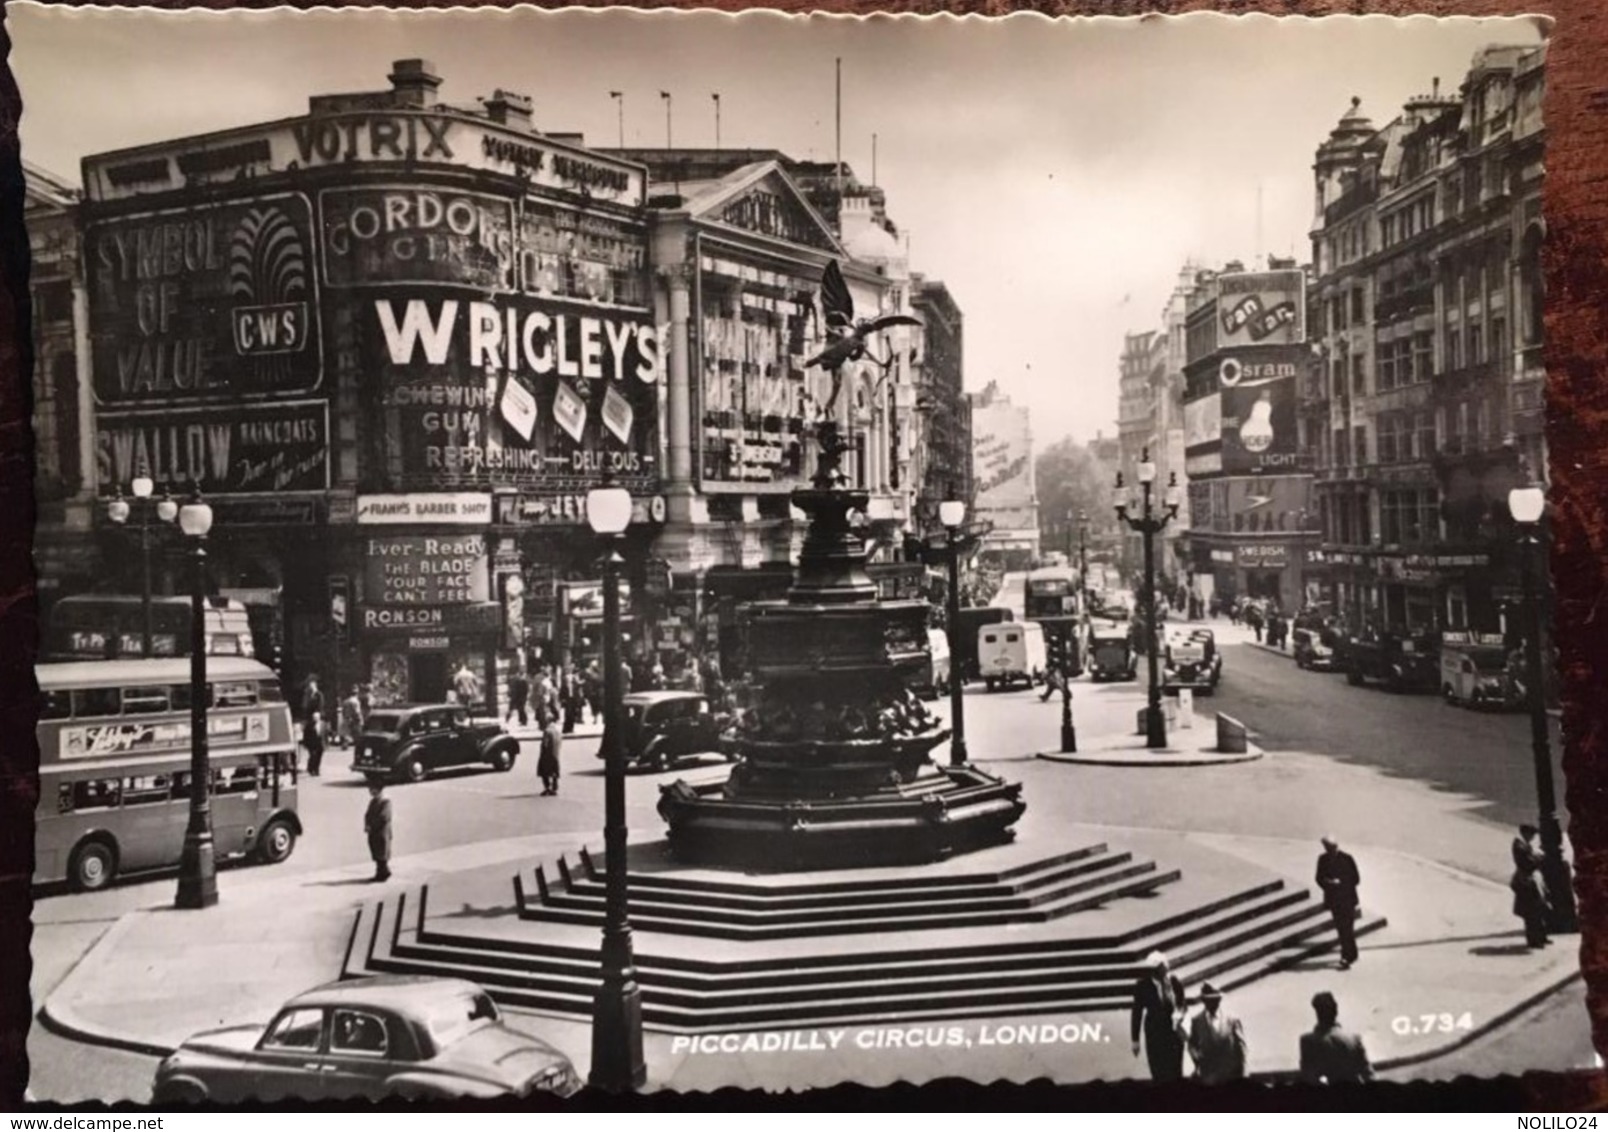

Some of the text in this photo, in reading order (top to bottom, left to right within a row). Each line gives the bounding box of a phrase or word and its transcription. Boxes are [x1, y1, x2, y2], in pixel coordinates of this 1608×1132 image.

[292, 114, 453, 162] VOTRIX
[98, 220, 223, 281] SYMBOL
[138, 283, 180, 335] OF
[240, 311, 296, 348] CWS
[374, 299, 659, 384] WRIGLEY'S
[1220, 358, 1296, 386] Osram
[394, 385, 496, 407] CHEWING
[422, 412, 480, 432] GUM
[98, 425, 231, 484] SWALLOW
[427, 446, 640, 471] REFRESHING DELIOUS
[1259, 454, 1296, 466] LIGHT
[416, 503, 457, 514] BARBER
[384, 560, 473, 575] THE BLADE
[385, 575, 473, 589] YOUR FACE
[383, 588, 473, 601] CAN'T FEEL
[365, 609, 442, 627] RONSON
